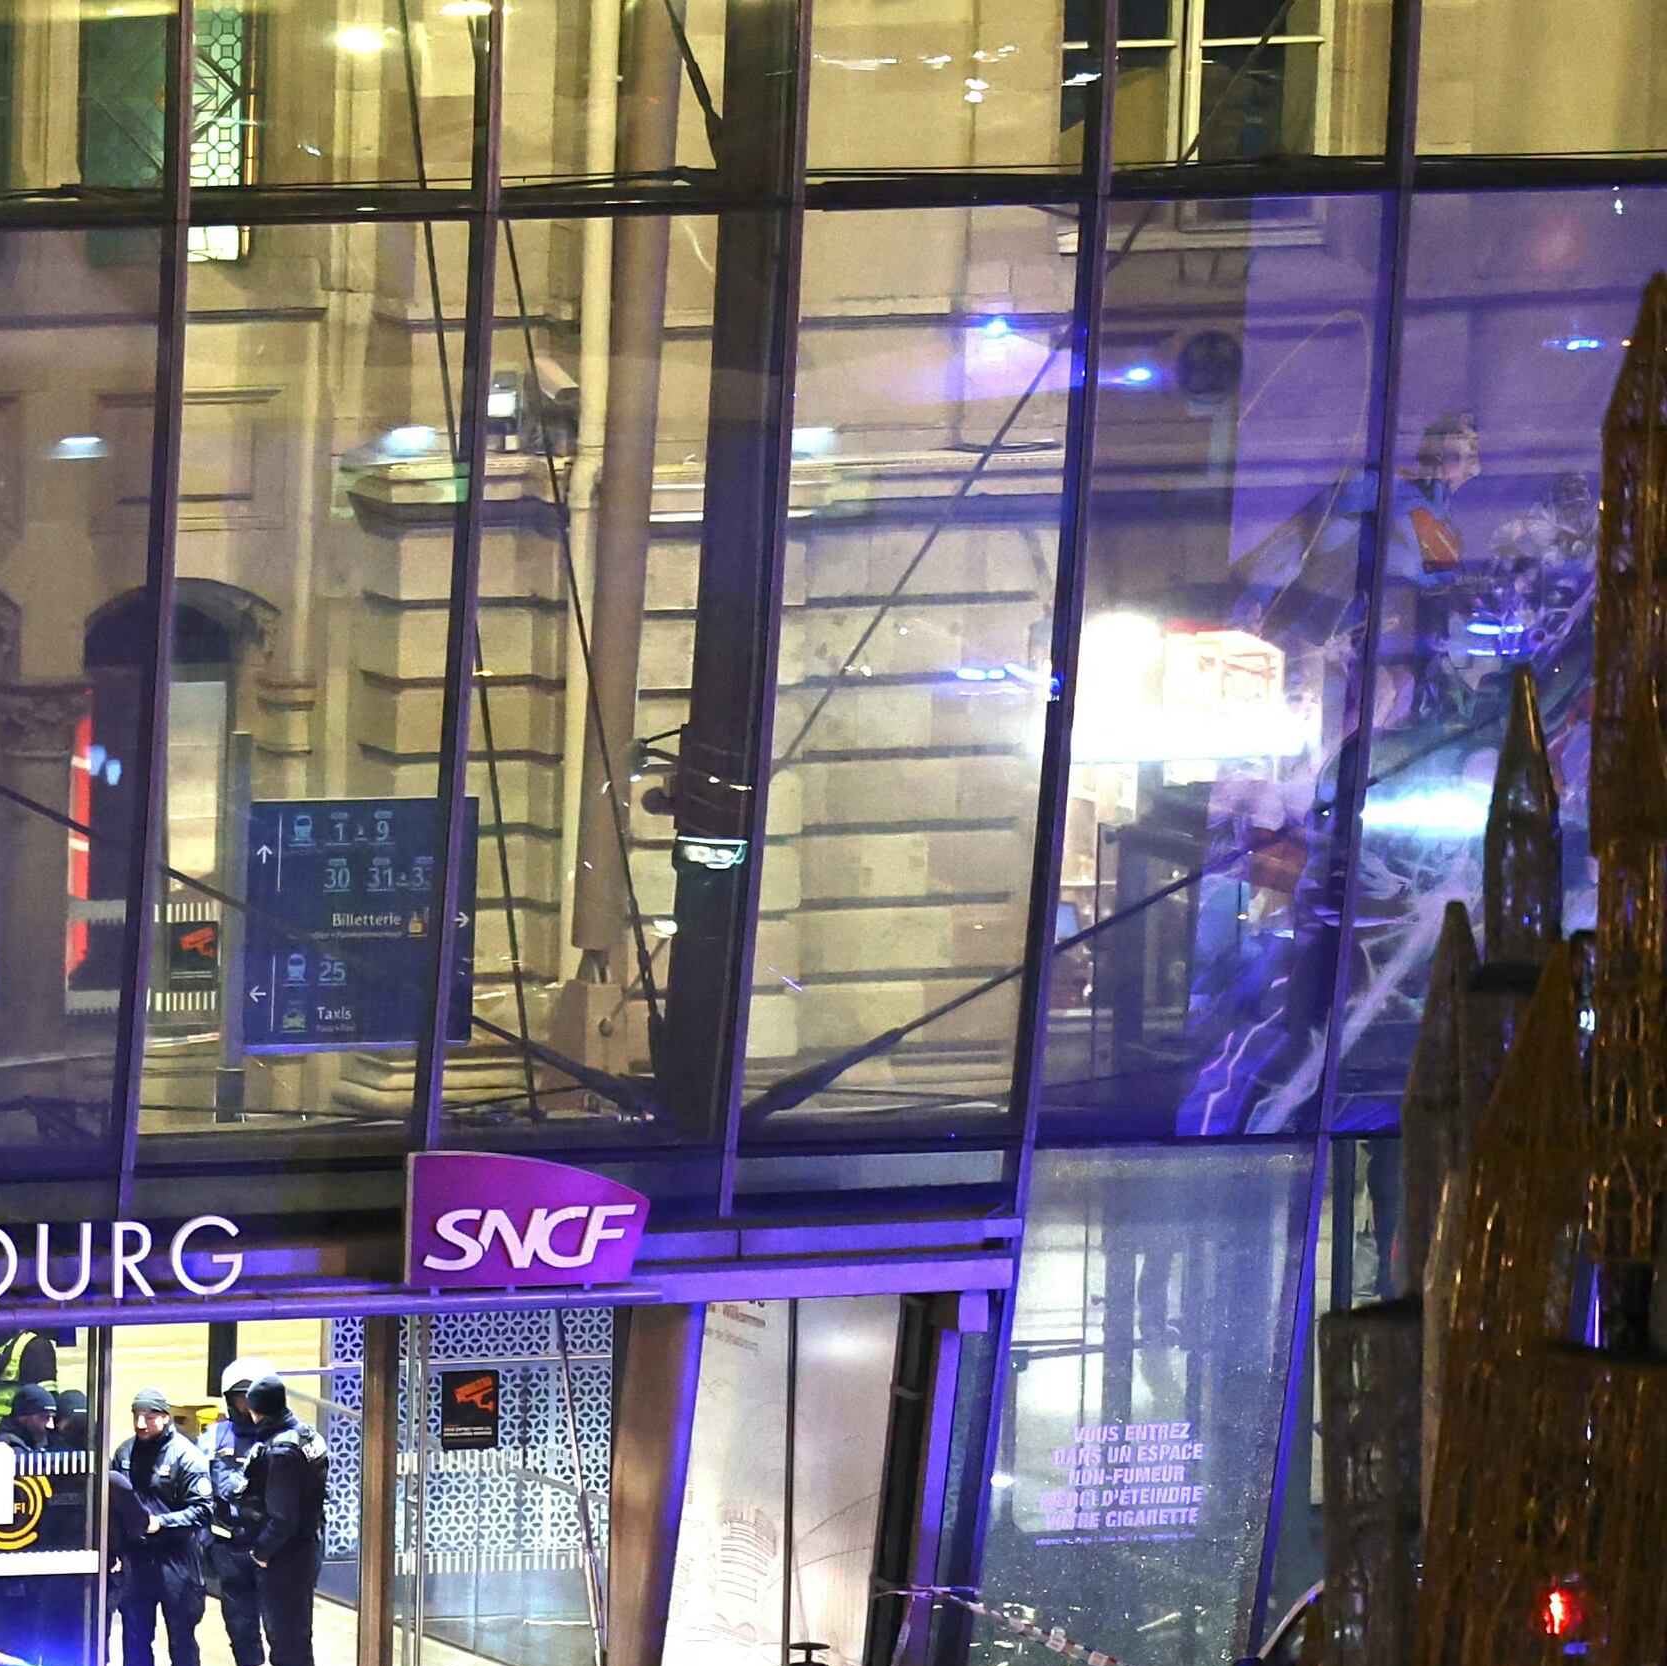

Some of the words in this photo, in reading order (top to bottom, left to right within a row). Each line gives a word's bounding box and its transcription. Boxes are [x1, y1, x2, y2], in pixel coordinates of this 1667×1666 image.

[376, 820, 390, 841] 9
[323, 868, 351, 888] 30
[368, 867, 393, 888] 31
[332, 912, 402, 927] Billetterie
[319, 961, 347, 982] 25
[316, 1006, 352, 1020] Taxis
[423, 1203, 637, 1271] SNCF
[1125, 1422, 1191, 1441] ENTREZ
[1107, 1446, 1131, 1463] UN
[1137, 1443, 1204, 1462] ESPACE
[1068, 1465, 1185, 1486] NON-FUMEUR
[1105, 1507, 1199, 1527] CIGARETTE
